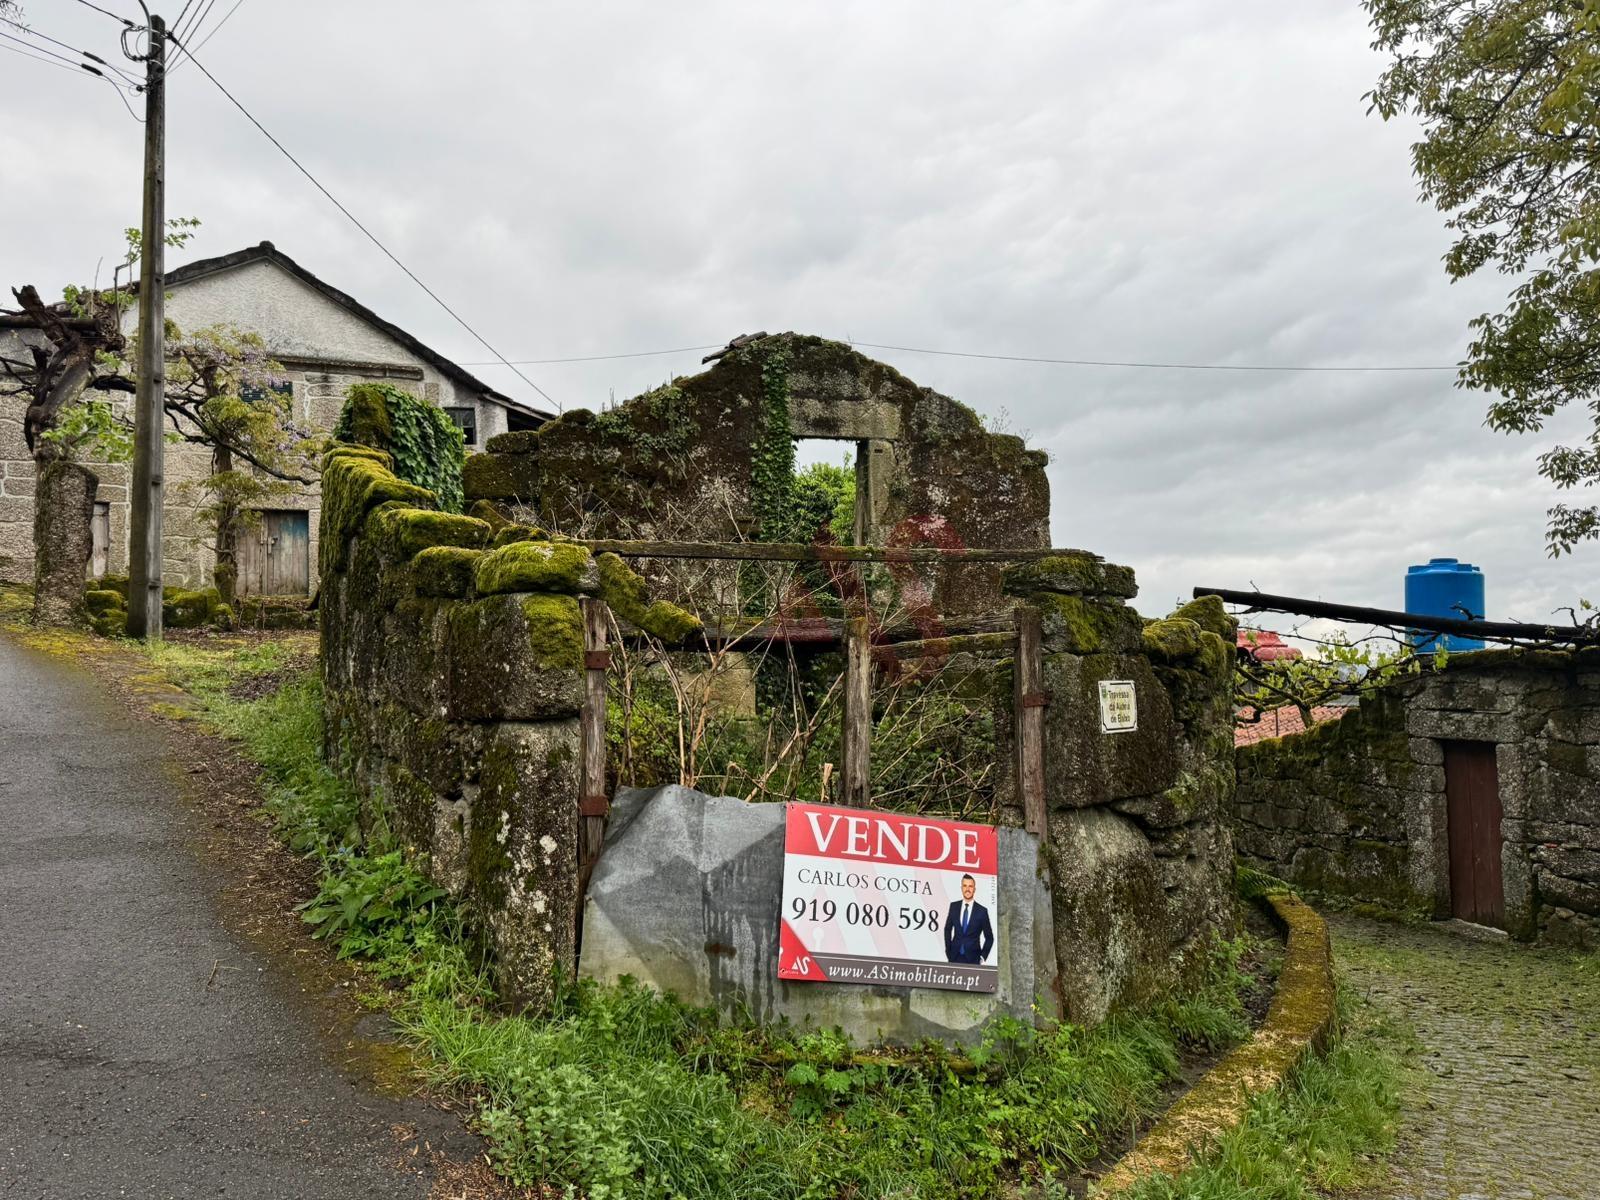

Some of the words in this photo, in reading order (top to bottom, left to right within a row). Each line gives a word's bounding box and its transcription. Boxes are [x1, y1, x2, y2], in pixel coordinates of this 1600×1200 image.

[1110, 715, 1117, 723] de
[804, 811, 980, 868] VENDE
[797, 868, 869, 889] CARLOS
[874, 877, 933, 896] COSTA
[792, 897, 837, 923] 919
[846, 901, 889, 928] 080
[898, 907, 940, 932] 598
[828, 965, 980, 990] www.ASimobiliaria.pt
